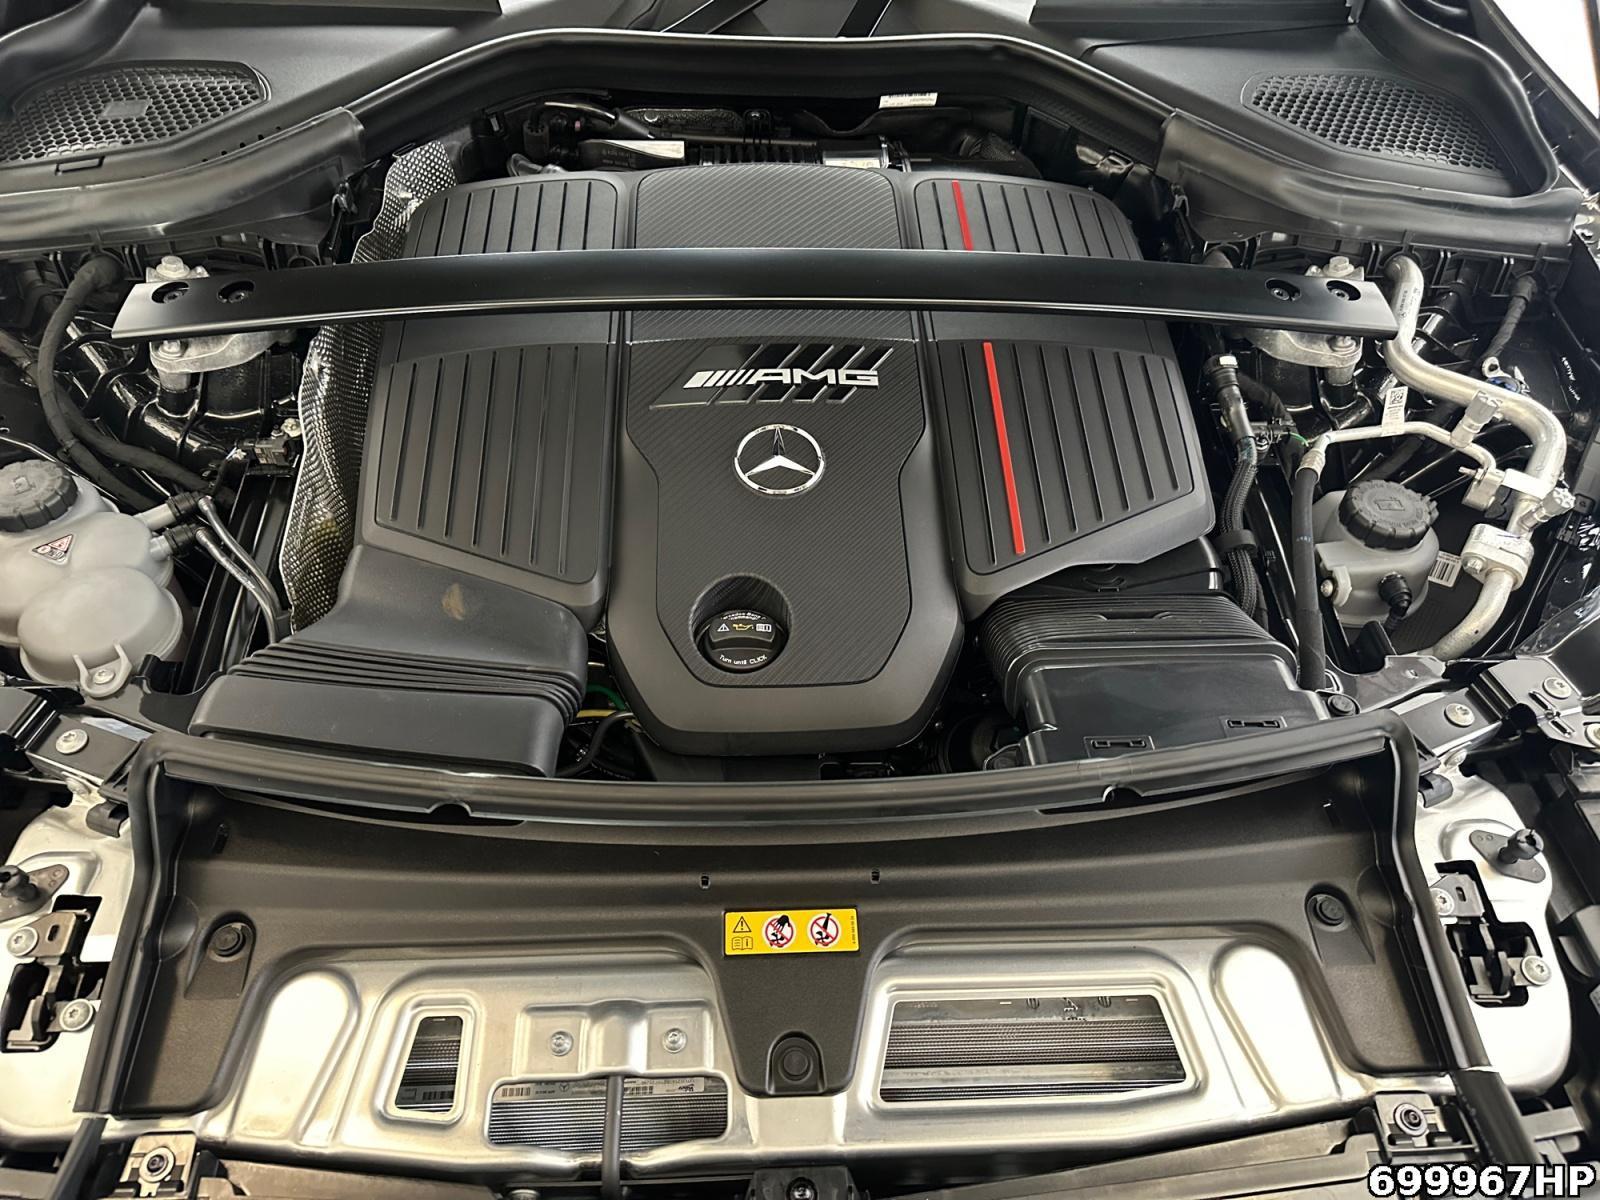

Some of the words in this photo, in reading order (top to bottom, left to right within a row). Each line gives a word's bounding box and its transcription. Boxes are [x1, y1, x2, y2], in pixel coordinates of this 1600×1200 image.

[746, 368, 879, 387] AMG
[719, 654, 732, 663] Turn
[749, 654, 767, 664] CLICK
